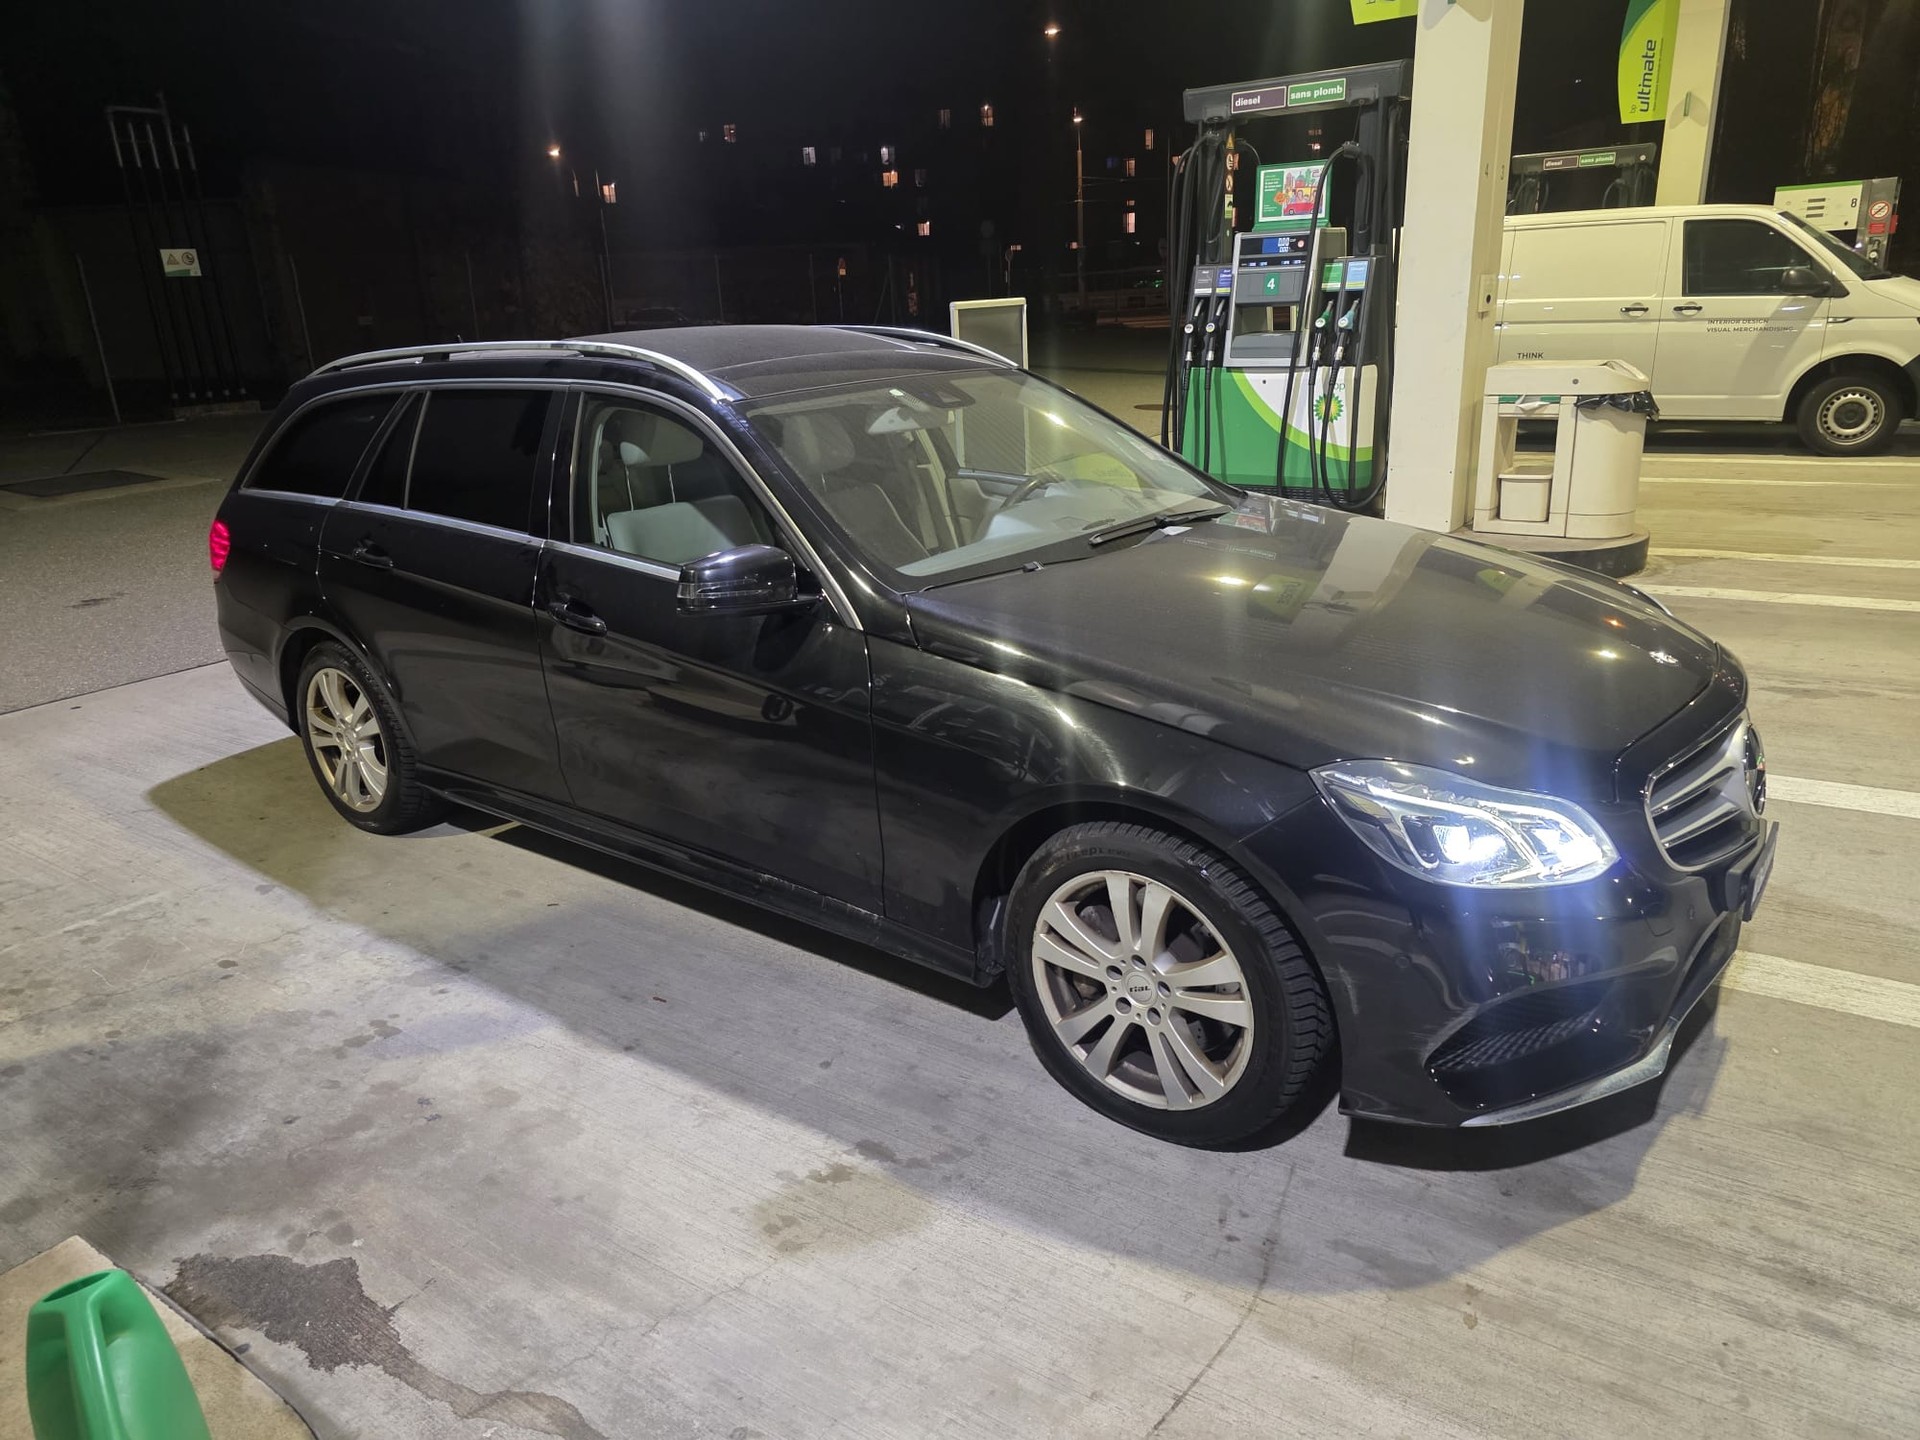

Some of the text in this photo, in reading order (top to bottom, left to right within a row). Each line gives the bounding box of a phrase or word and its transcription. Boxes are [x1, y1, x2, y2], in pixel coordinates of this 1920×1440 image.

[1637, 39, 1657, 112] ultimate
[1290, 85, 1343, 100] sans plomb
[1235, 95, 1260, 107] diesel
[1850, 198, 1858, 208] 8
[1266, 277, 1276, 290] 4
